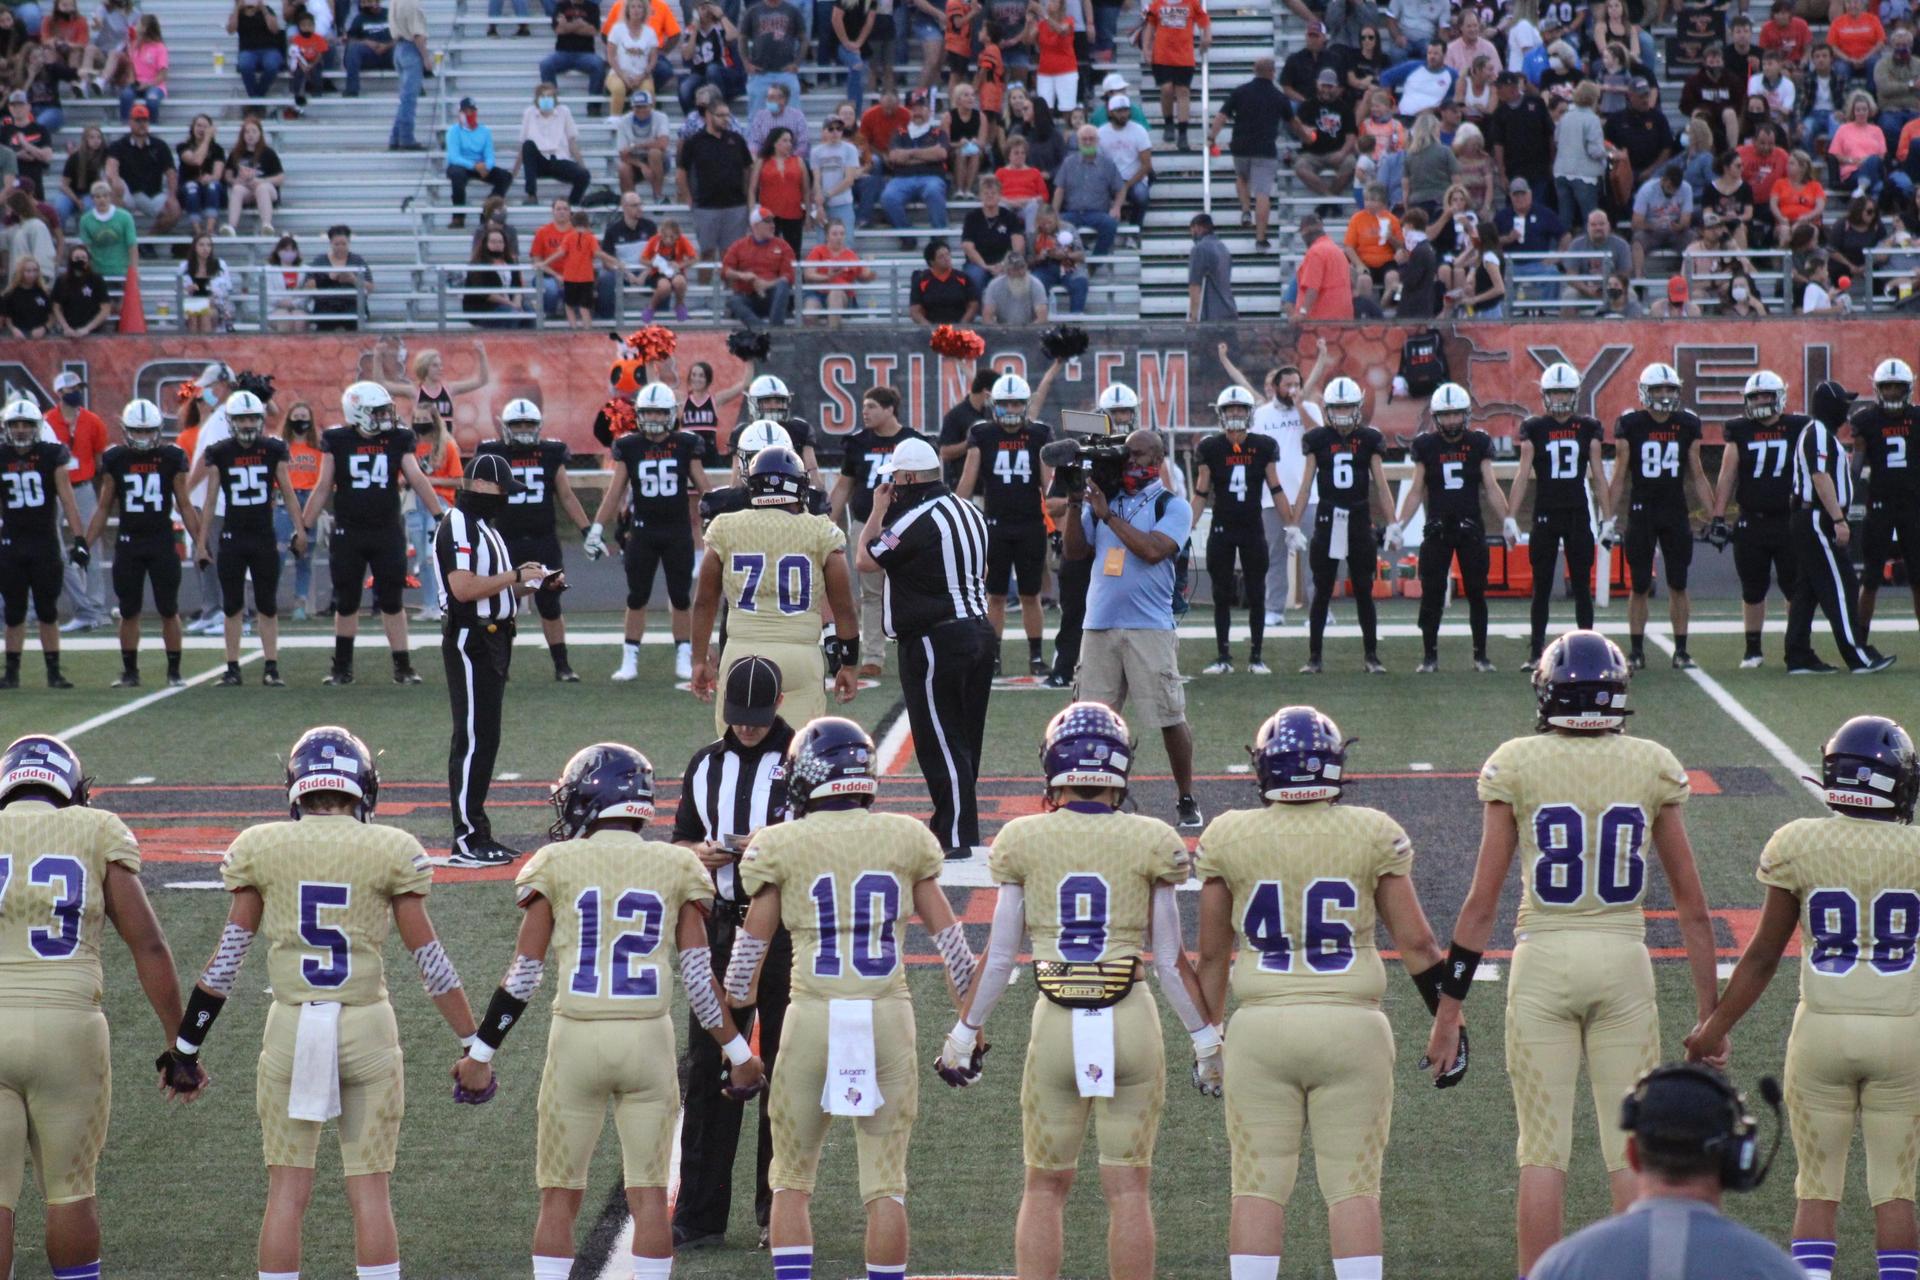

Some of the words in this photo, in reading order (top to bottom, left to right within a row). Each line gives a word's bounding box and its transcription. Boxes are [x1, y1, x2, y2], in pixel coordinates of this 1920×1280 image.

[683, 411, 714, 424] LLANO
[993, 450, 1032, 485] 44
[1332, 451, 1354, 490] 6
[1545, 439, 1580, 480] 13
[1641, 442, 1680, 479] 84
[1747, 439, 1788, 479] 77
[1885, 435, 1907, 469] 2
[2, 471, 45, 509] 30
[228, 466, 268, 506] 25
[350, 454, 389, 490] 54
[638, 459, 679, 498] 66
[1229, 463, 1247, 502] 4
[1442, 462, 1464, 490] 5
[124, 473, 163, 513] 24
[757, 496, 787, 506] Riddell
[731, 552, 813, 617] 70
[1566, 718, 1613, 729] Riddell
[9, 768, 56, 783] Riddell
[298, 777, 346, 792] Riddell
[831, 782, 874, 793] Riddell
[1066, 774, 1113, 784] Riddell
[1280, 788, 1328, 800] Riddell
[625, 805, 655, 818] Ridde
[1828, 792, 1874, 807] Riddell
[1532, 803, 1648, 906] 80
[0, 853, 87, 960] 3
[809, 869, 901, 979] 10
[1056, 872, 1110, 963] 8
[1241, 877, 1358, 974] 46
[298, 881, 353, 990] 5
[569, 886, 667, 999] 12
[1807, 887, 1920, 977] 88
[1063, 987, 1102, 997] BATTLE
